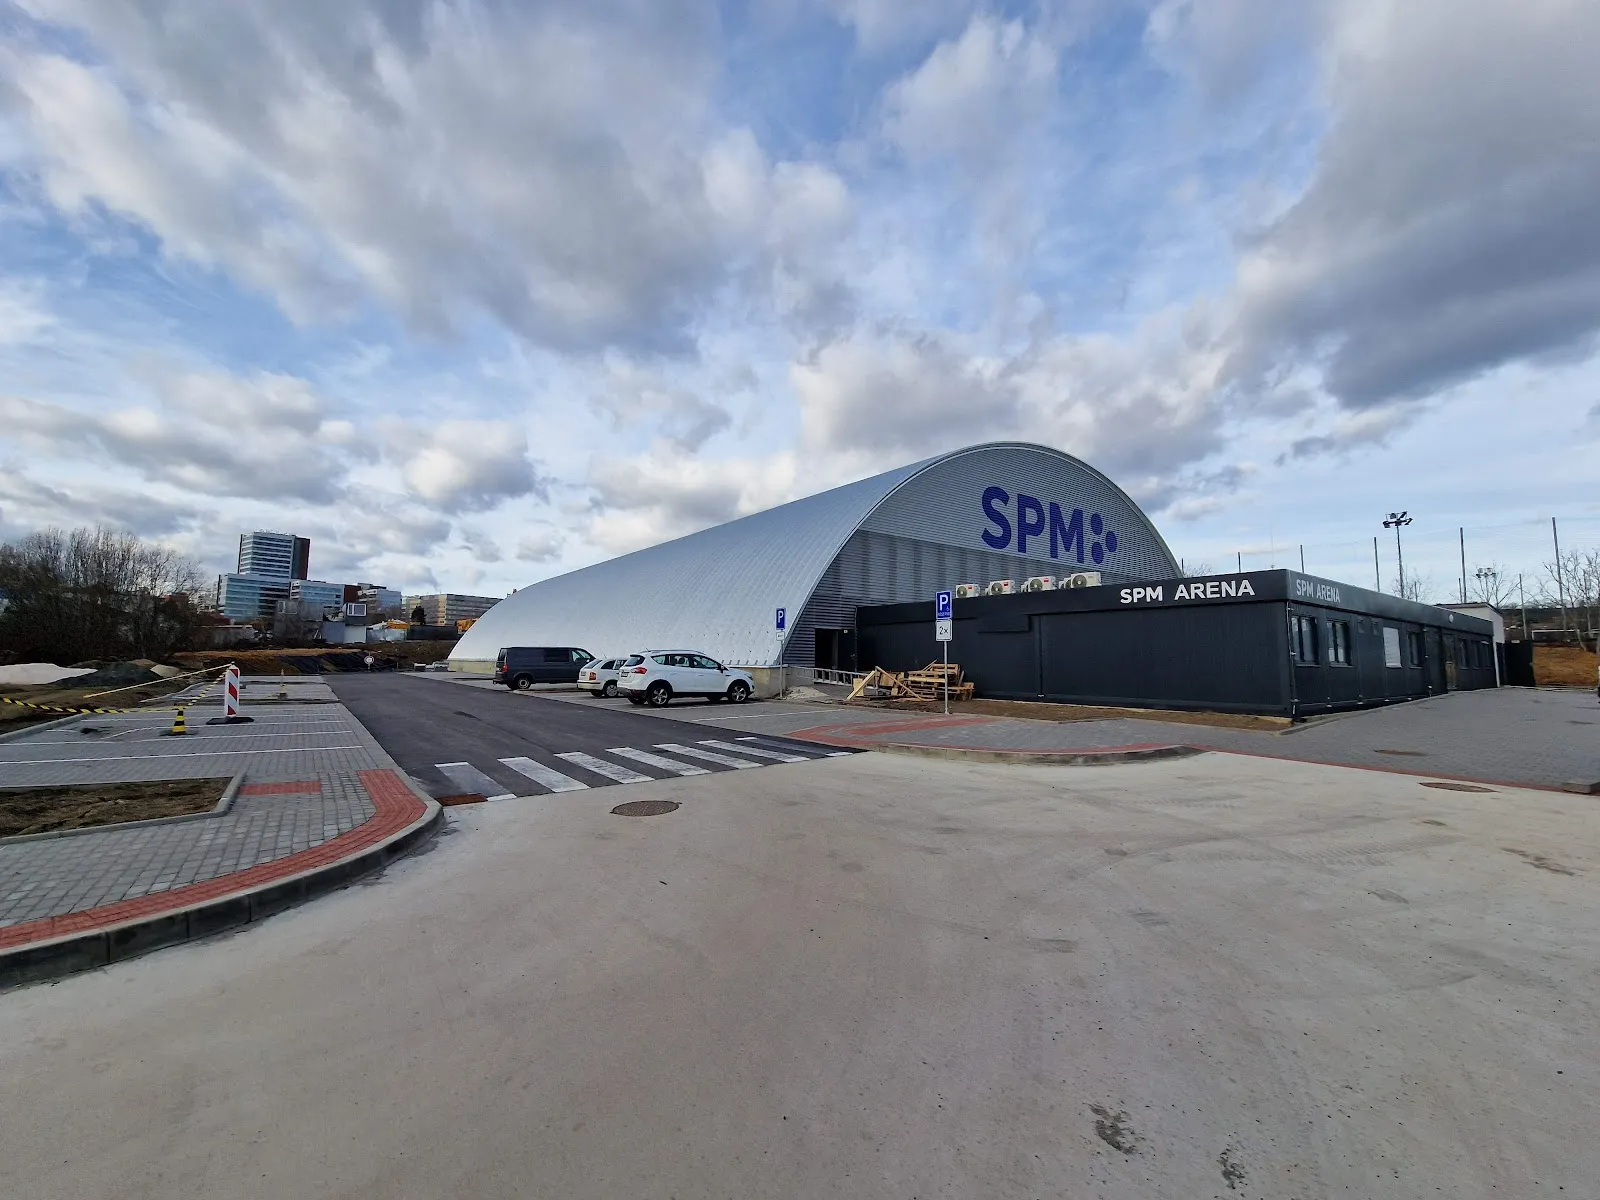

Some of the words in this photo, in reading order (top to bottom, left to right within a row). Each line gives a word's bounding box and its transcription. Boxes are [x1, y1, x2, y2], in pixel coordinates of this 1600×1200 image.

[981, 486, 1085, 564] SPM
[939, 594, 949, 611] P
[1120, 585, 1163, 604] SPM
[1174, 579, 1255, 601] ARENA
[1296, 579, 1314, 598] SPM
[1316, 584, 1341, 603] ARENA
[777, 610, 784, 623] P
